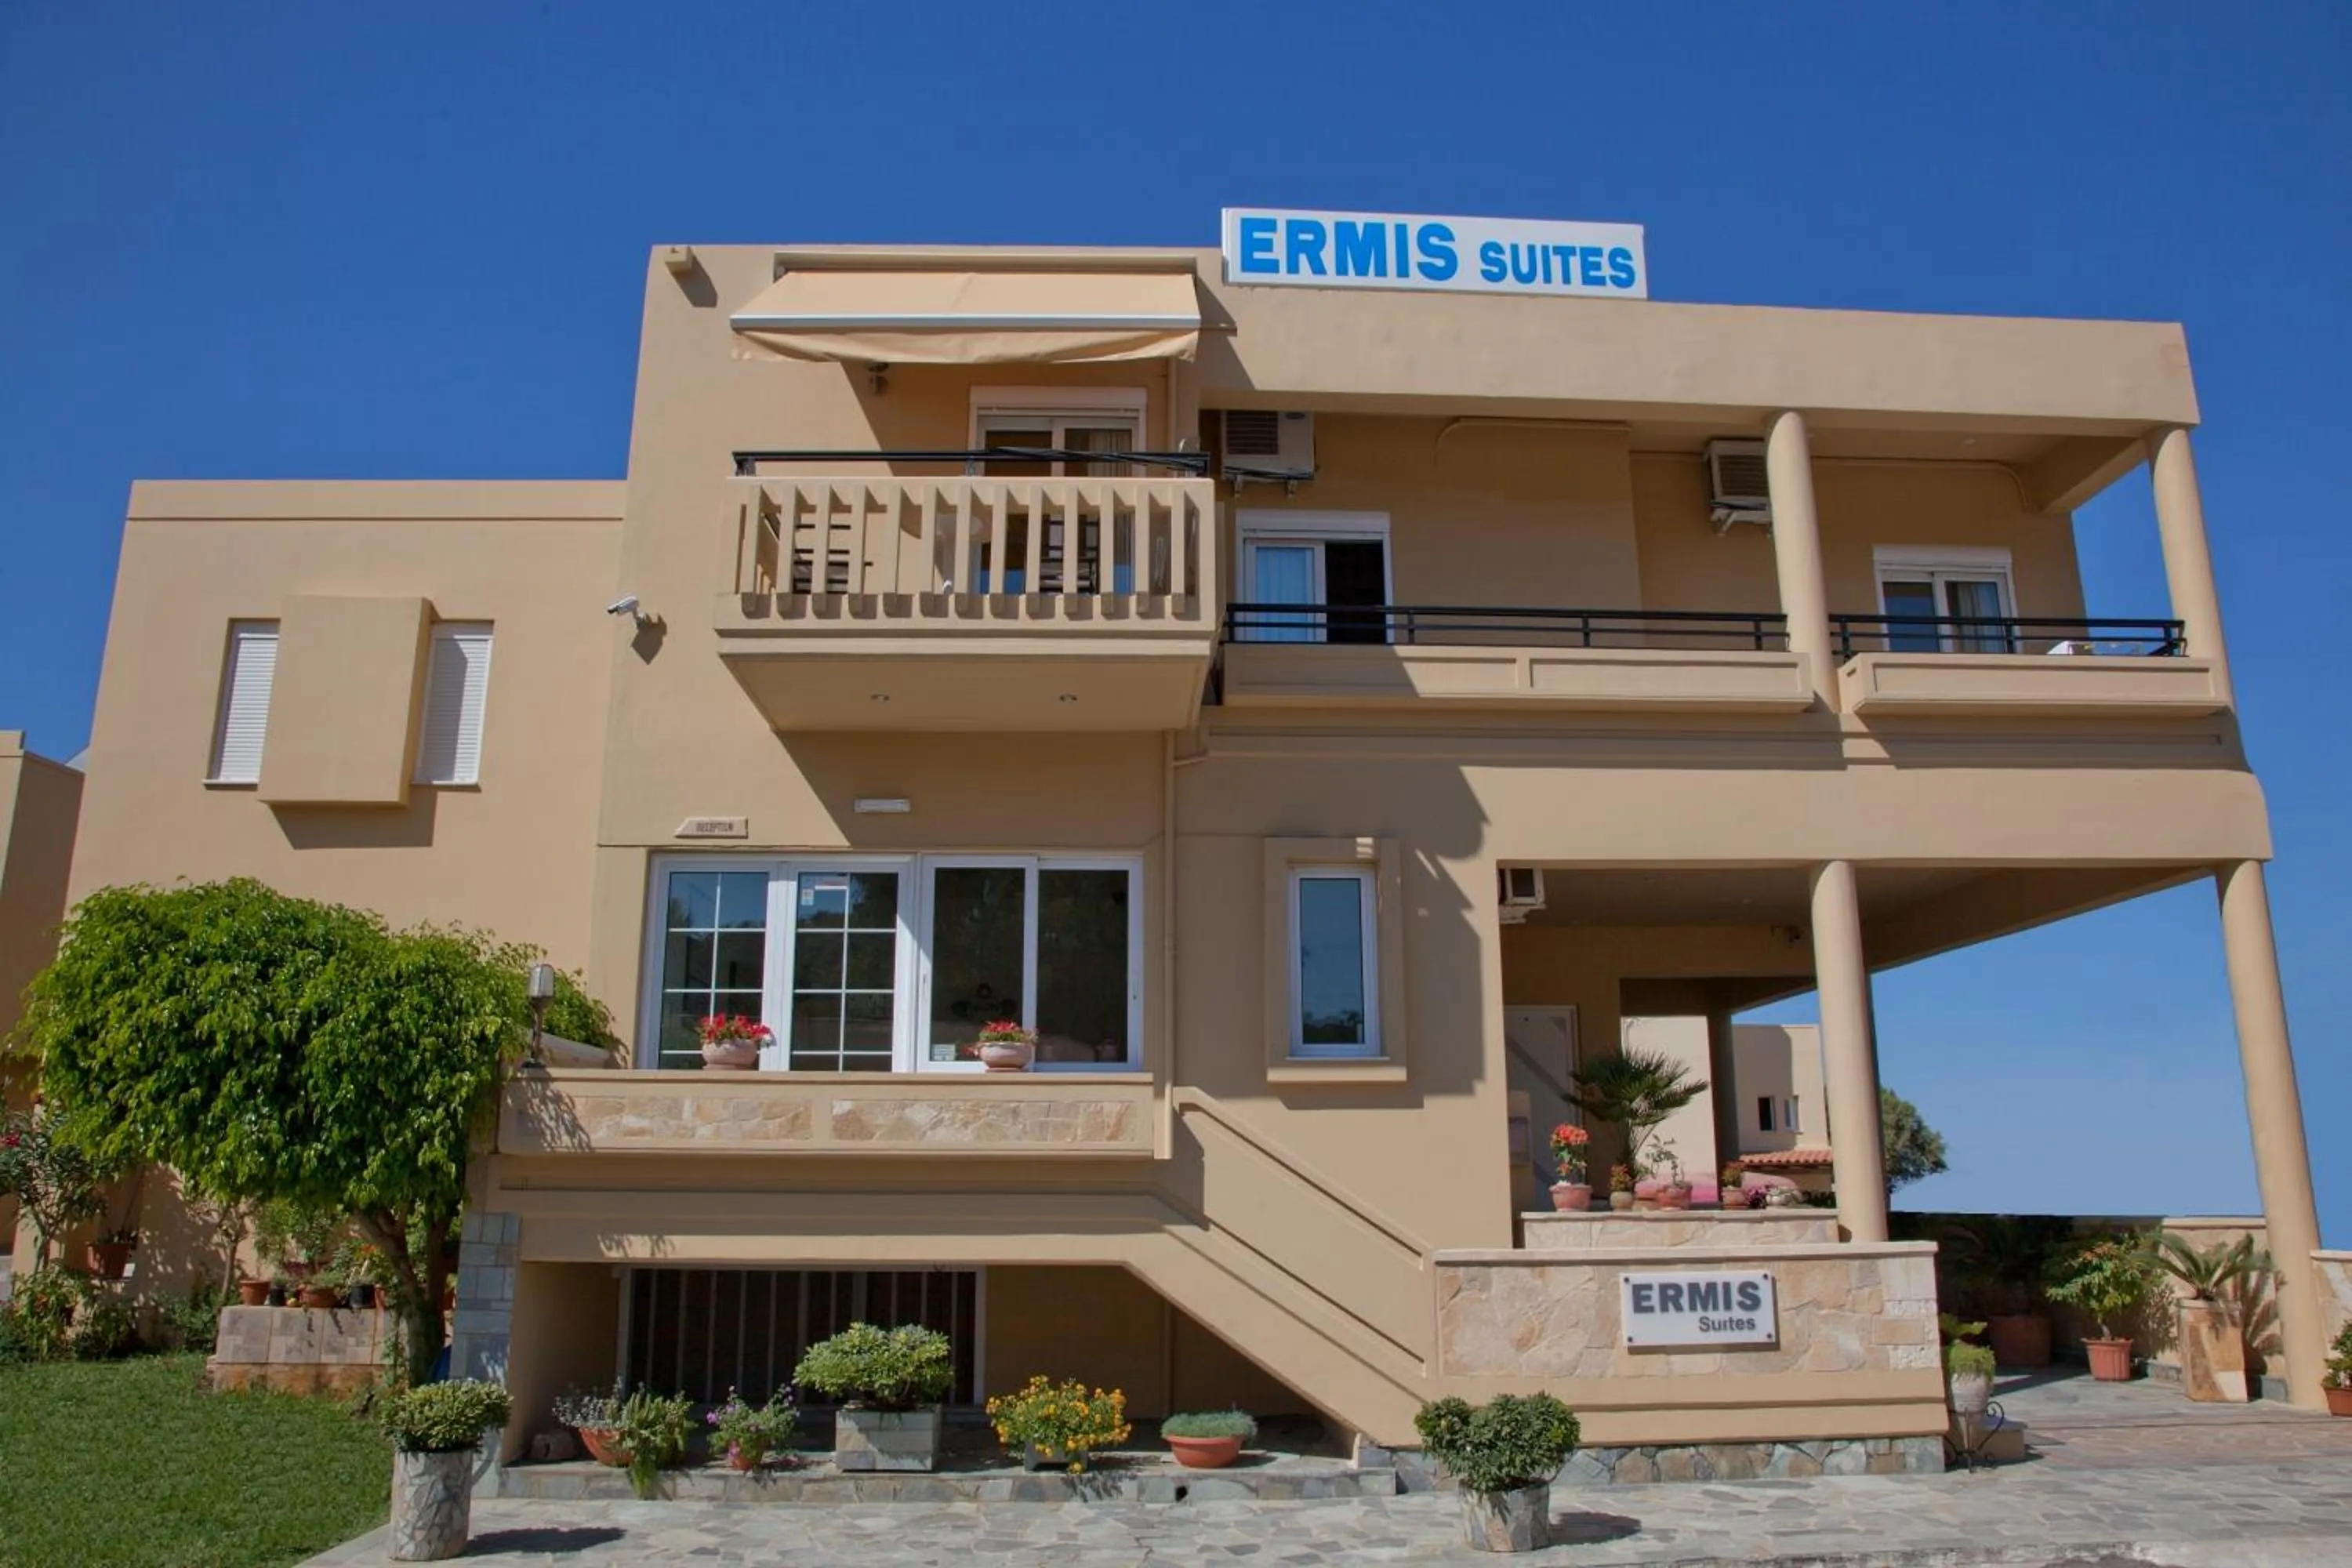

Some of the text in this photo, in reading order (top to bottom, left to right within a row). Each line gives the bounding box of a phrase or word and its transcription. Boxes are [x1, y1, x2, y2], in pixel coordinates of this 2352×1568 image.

[1240, 218, 1635, 289] ERMIS SUITES
[1632, 1281, 1762, 1313] ERMIS
[1698, 1316, 1756, 1332] Suites
